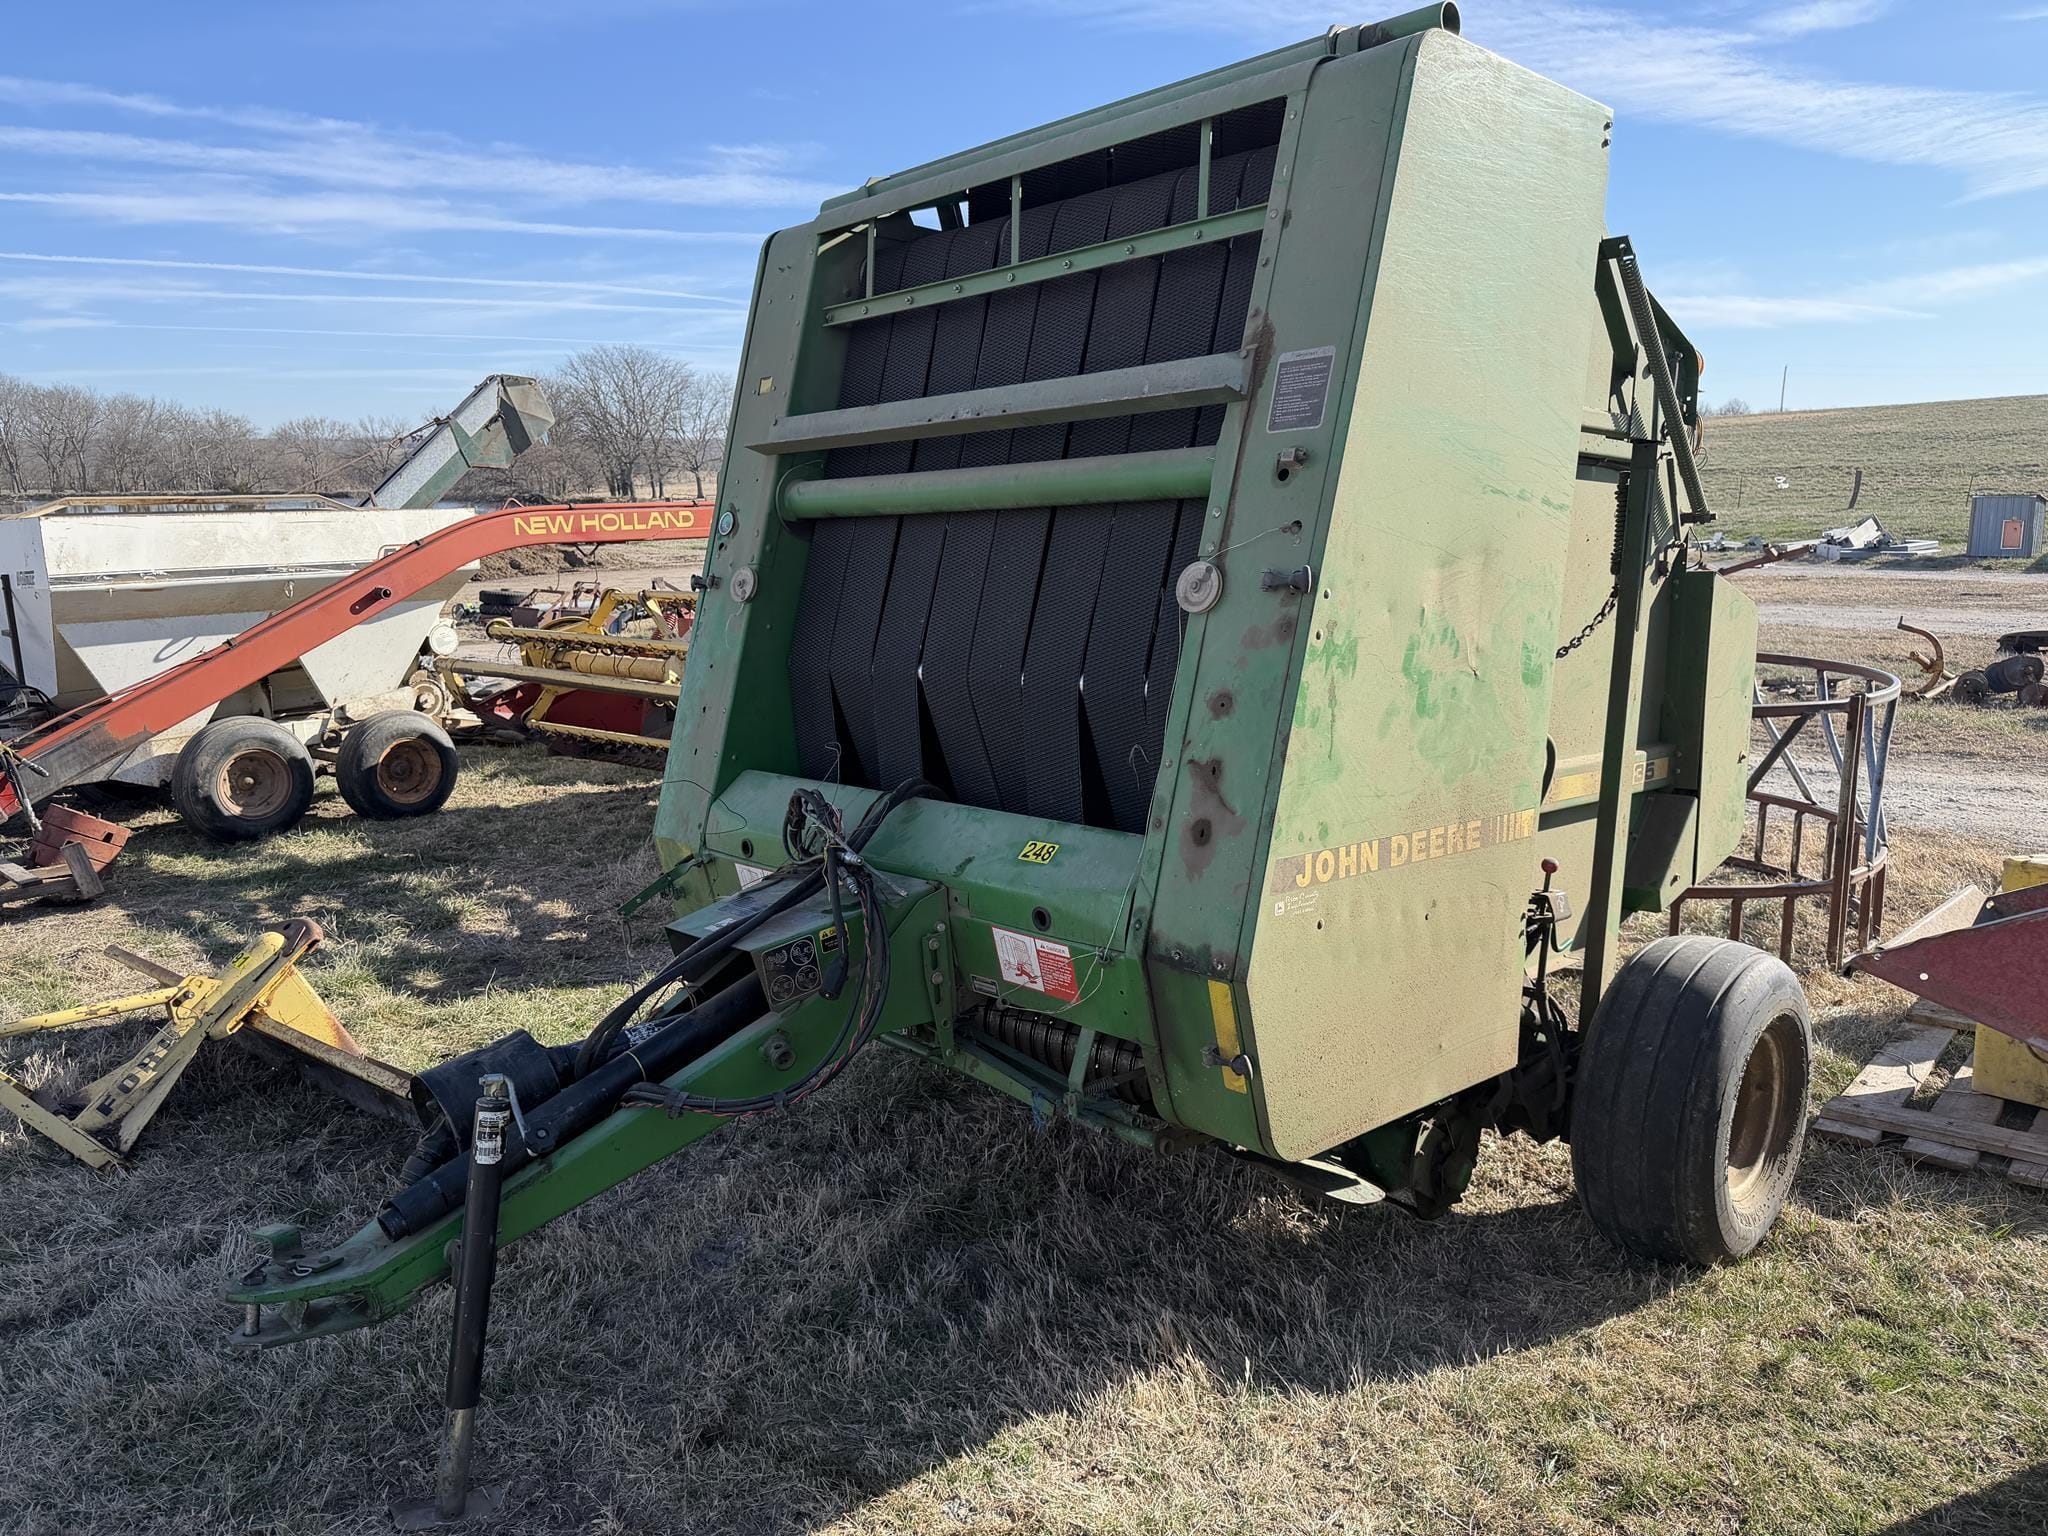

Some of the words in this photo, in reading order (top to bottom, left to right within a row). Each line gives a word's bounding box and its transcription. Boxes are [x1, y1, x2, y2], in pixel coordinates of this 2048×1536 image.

[513, 514, 575, 536] NEW
[580, 510, 695, 533] HOLLAND
[1020, 842, 1056, 862] 248
[1295, 839, 1380, 889] JOHN
[1390, 819, 1483, 868] DEERE
[95, 1038, 171, 1118] FORD
